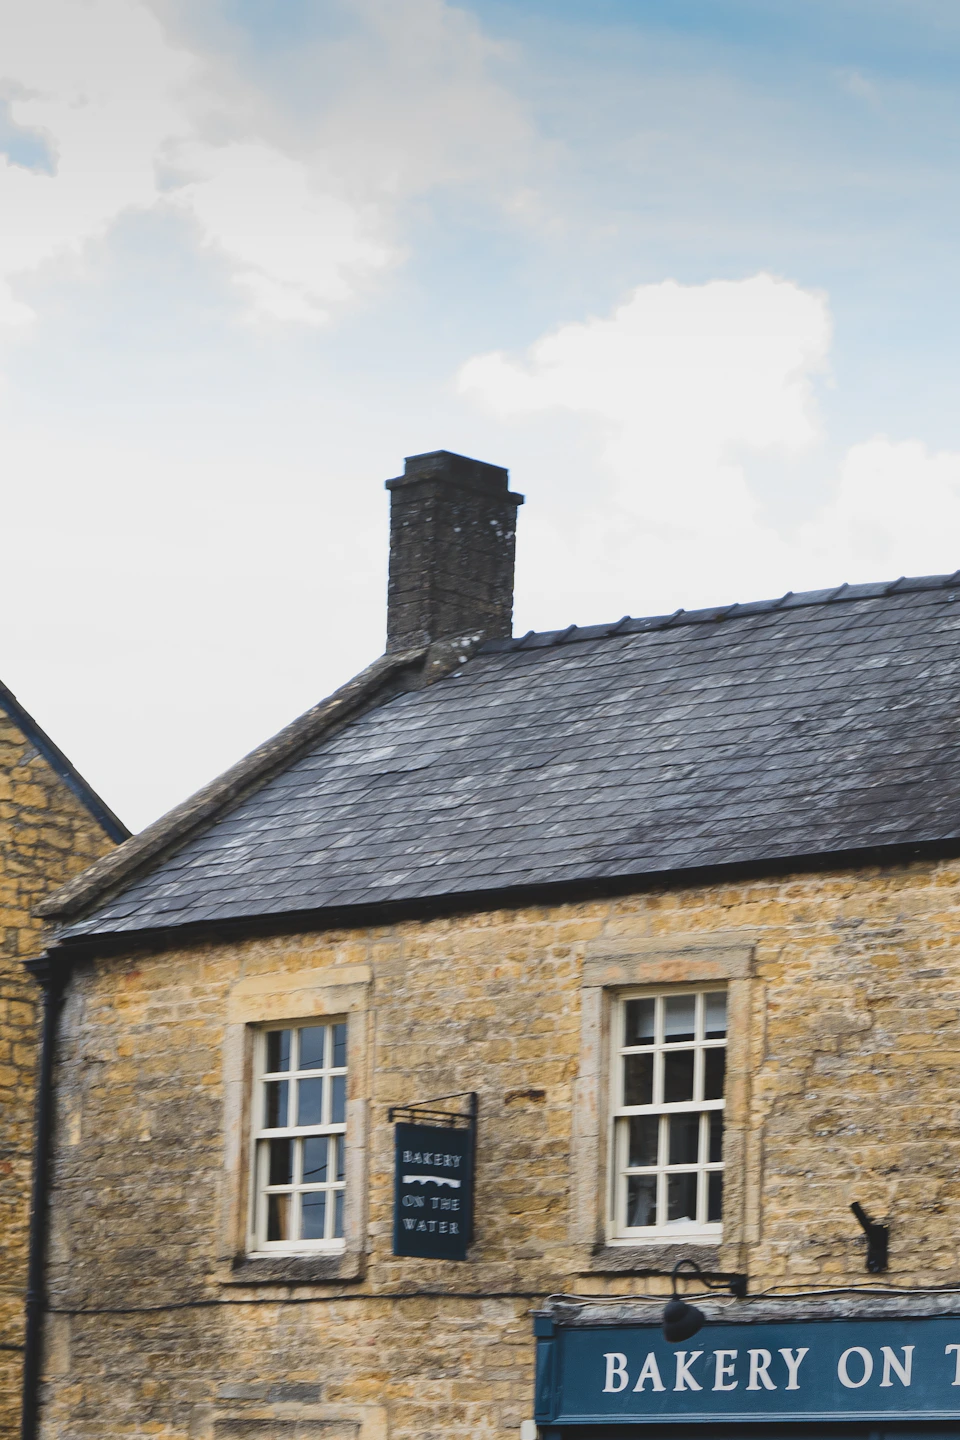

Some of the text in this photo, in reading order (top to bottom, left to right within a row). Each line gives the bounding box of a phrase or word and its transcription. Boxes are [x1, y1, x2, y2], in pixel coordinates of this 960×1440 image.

[402, 1150, 463, 1168] BAKERY
[402, 1195, 461, 1211] ON THE
[402, 1217, 460, 1235] WATER
[602, 1347, 810, 1393] BAKERY
[837, 1345, 916, 1389] ON
